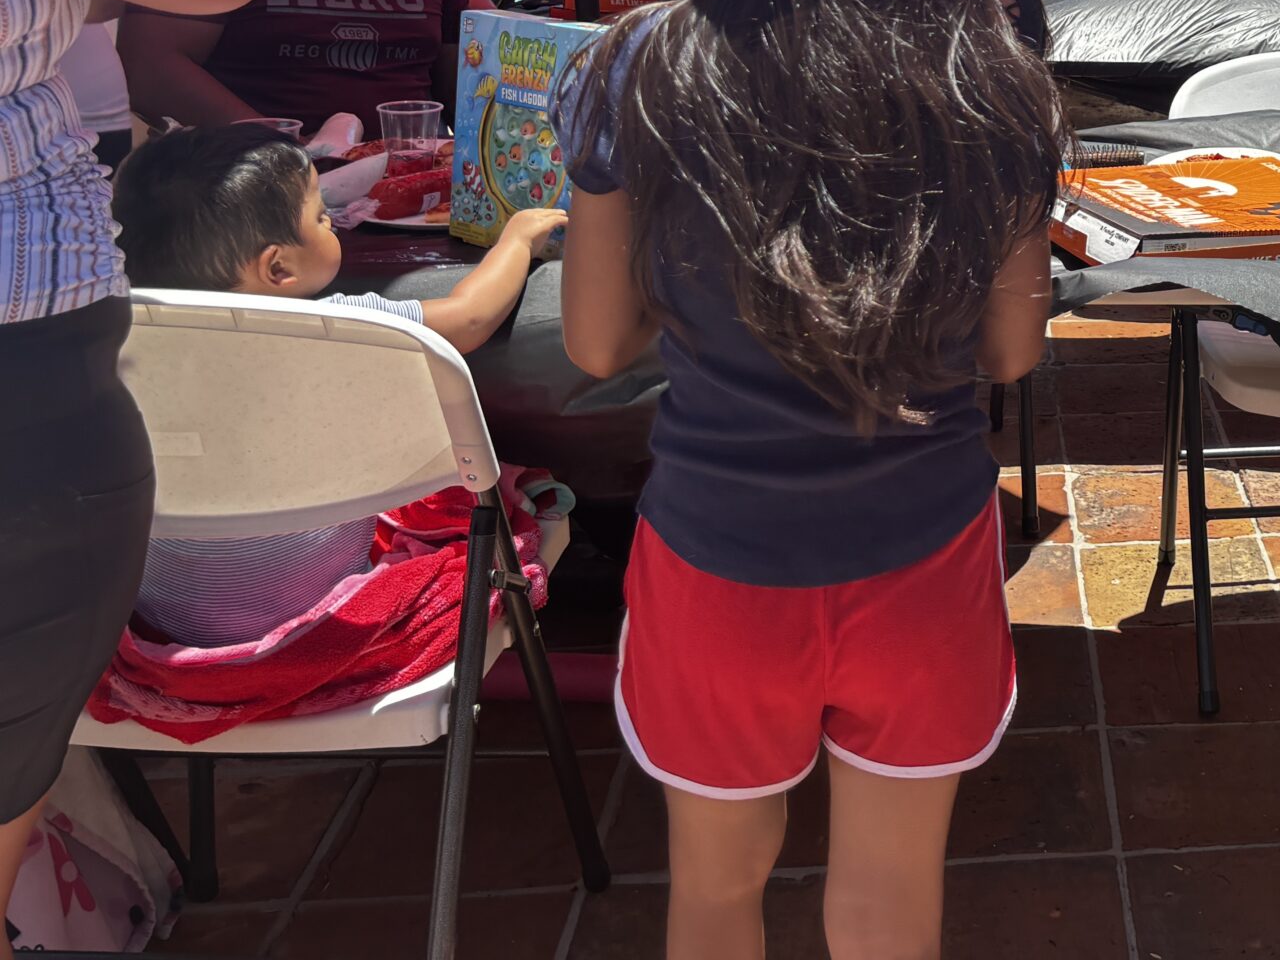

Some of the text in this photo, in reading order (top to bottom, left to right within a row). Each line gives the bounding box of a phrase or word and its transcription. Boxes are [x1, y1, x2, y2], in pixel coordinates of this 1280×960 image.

[342, 29, 370, 39] 1987
[279, 44, 419, 59] REG TMK
[499, 31, 557, 76] CATCH
[501, 64, 551, 92] FRENZY
[502, 88, 548, 107] FISH LAGOON
[1086, 178, 1226, 227] SPIDER-MAN
